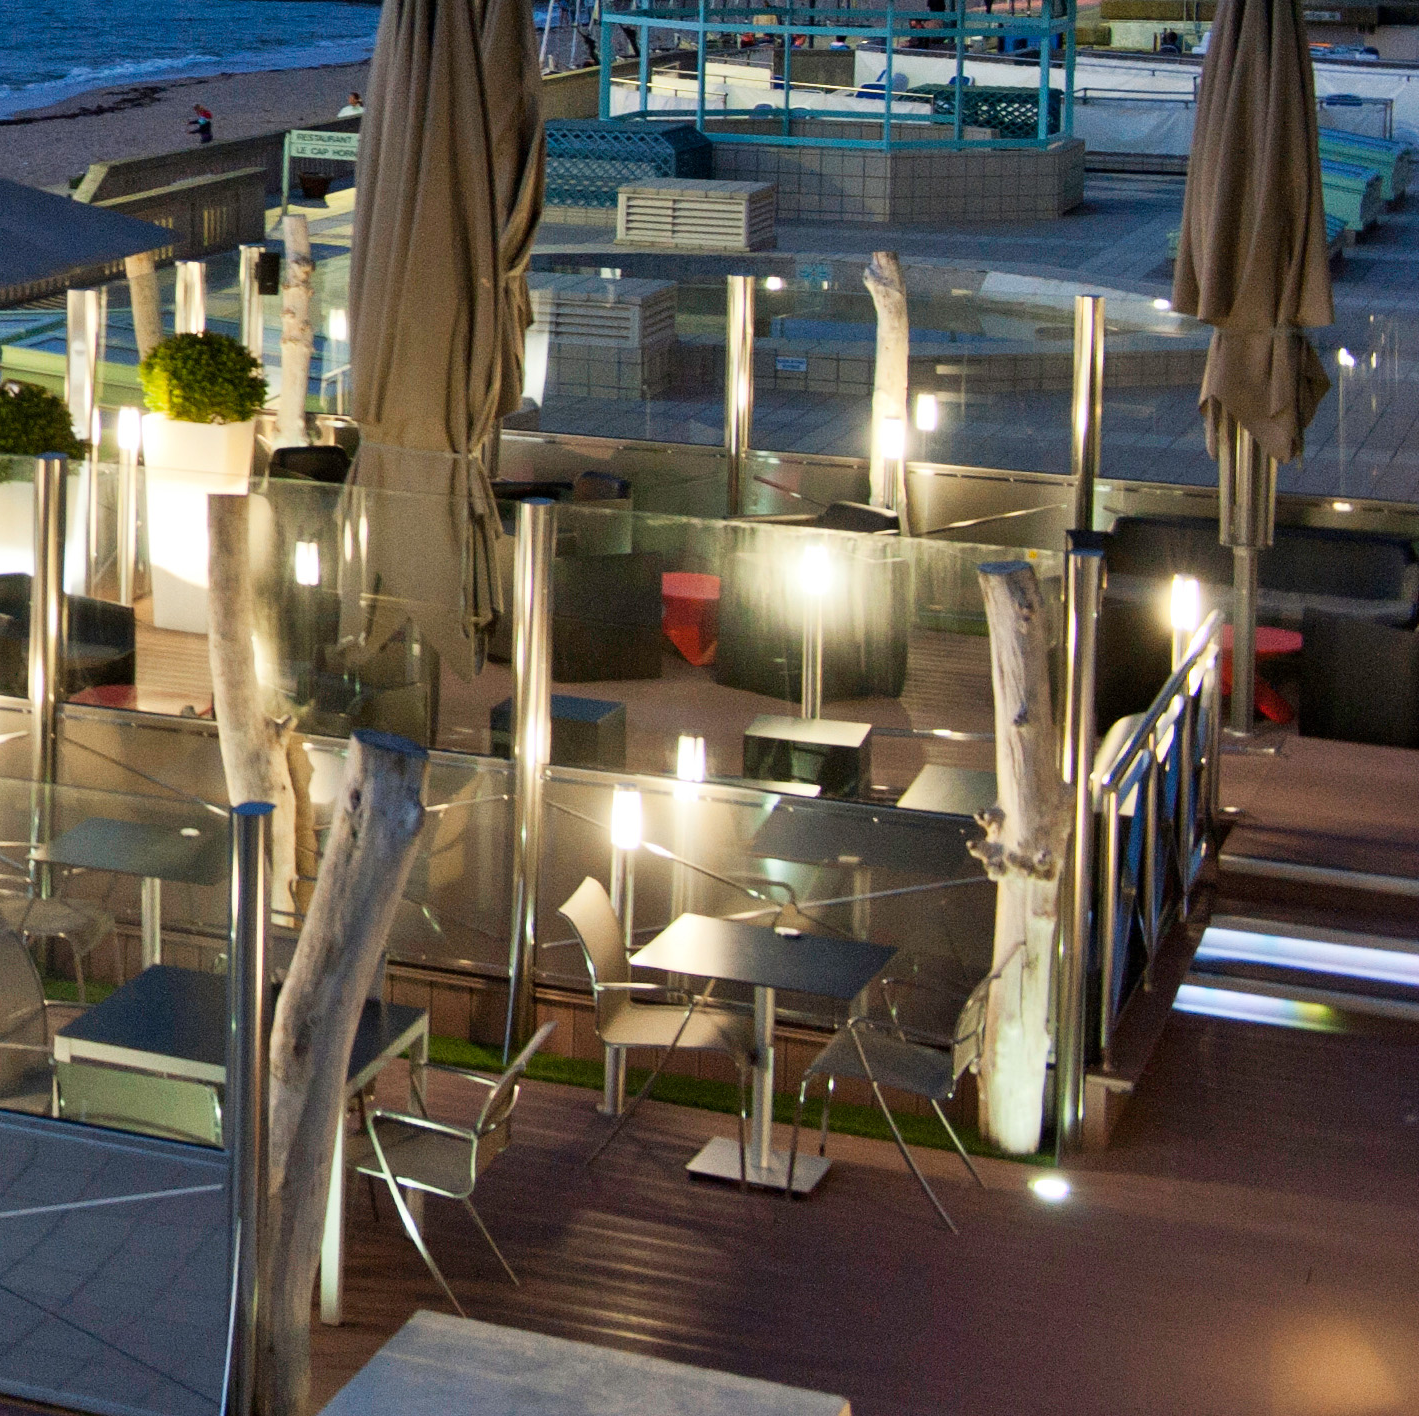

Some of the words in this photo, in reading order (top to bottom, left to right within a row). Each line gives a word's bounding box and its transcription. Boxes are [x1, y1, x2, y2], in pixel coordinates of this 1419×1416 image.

[296, 133, 352, 143] RESTAURANT
[296, 146, 307, 154] LE
[310, 147, 329, 155] CAP
